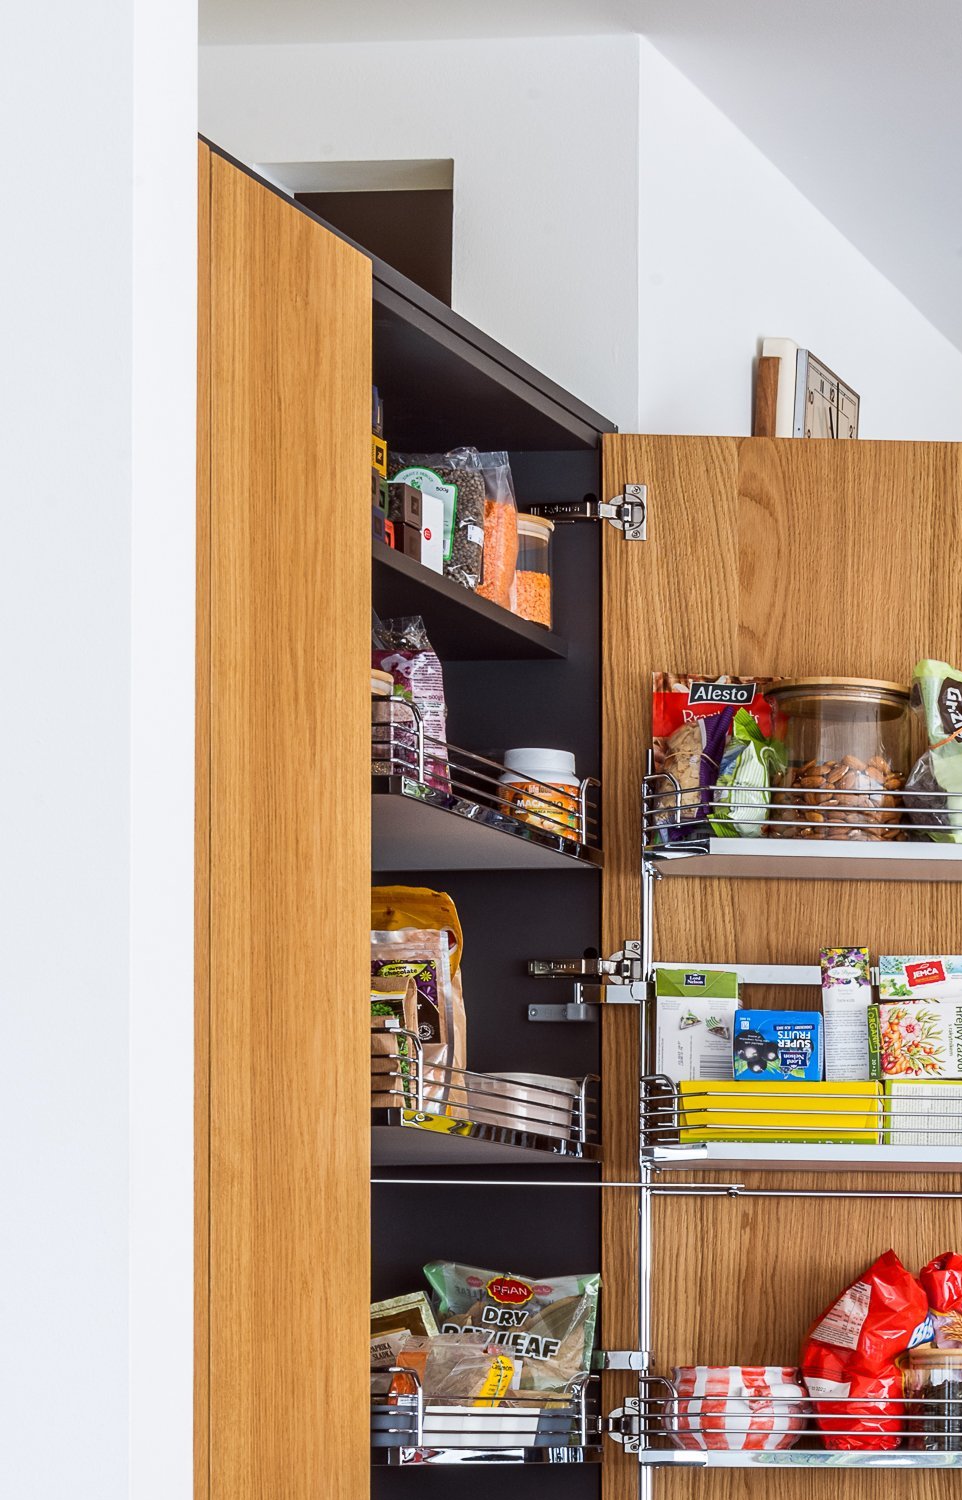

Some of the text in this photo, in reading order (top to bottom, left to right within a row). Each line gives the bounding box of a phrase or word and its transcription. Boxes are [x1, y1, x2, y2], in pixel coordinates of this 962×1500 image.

[694, 685, 748, 701] Alesto
[912, 967, 939, 979] JEMČA
[777, 1031, 811, 1039] FRUITS
[867, 1010, 879, 1046] ORGANI
[777, 1039, 811, 1048] SUPER
[483, 1306, 528, 1326] DRY
[498, 1332, 560, 1360] LEAF
